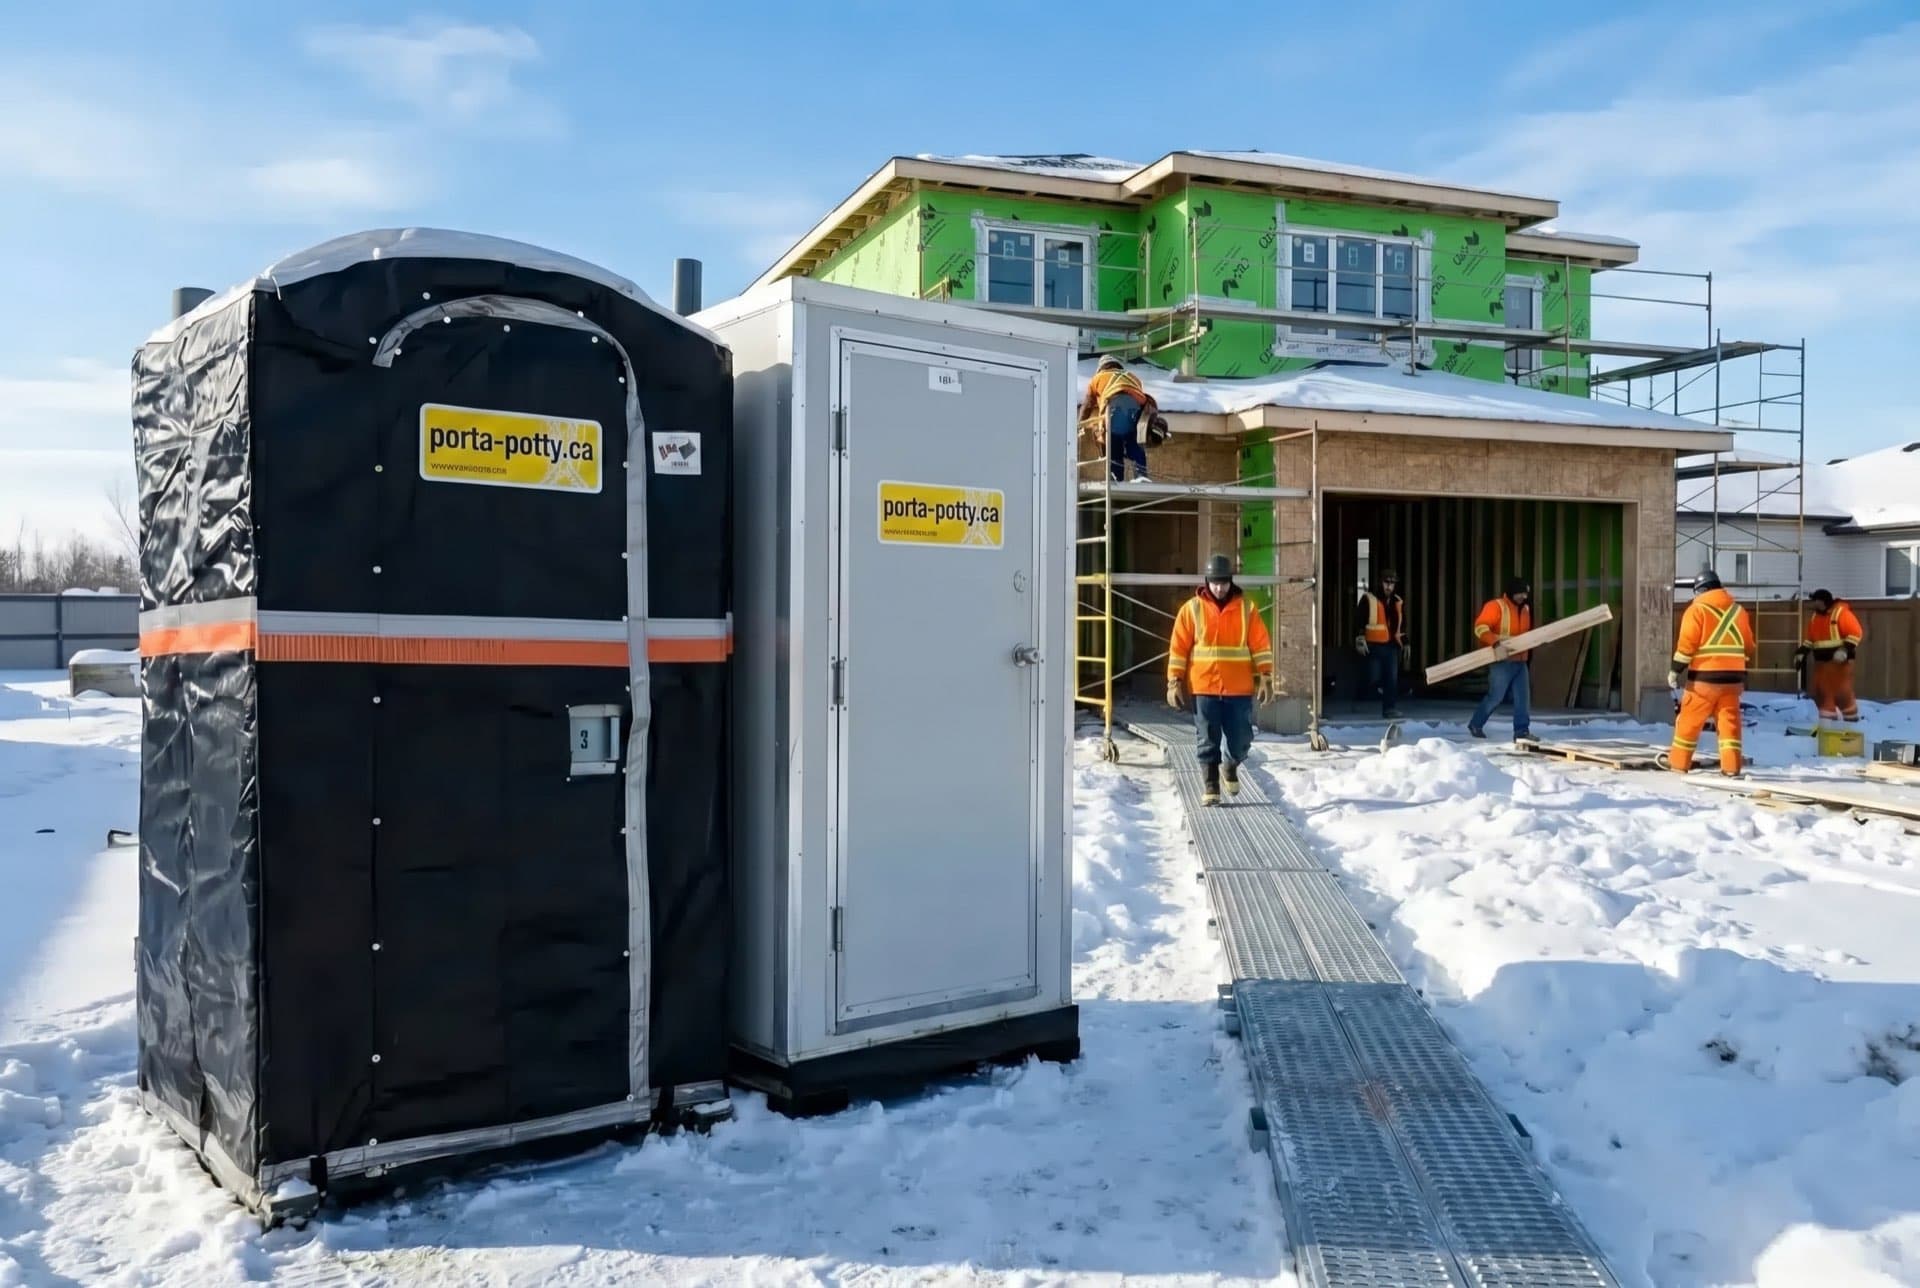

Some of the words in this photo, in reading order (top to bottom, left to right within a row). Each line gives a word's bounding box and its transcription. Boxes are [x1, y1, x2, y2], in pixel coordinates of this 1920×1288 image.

[430, 426, 593, 464] porta-potty.ca
[883, 497, 999, 526] porta-potty.ca
[580, 729, 589, 749] 3
